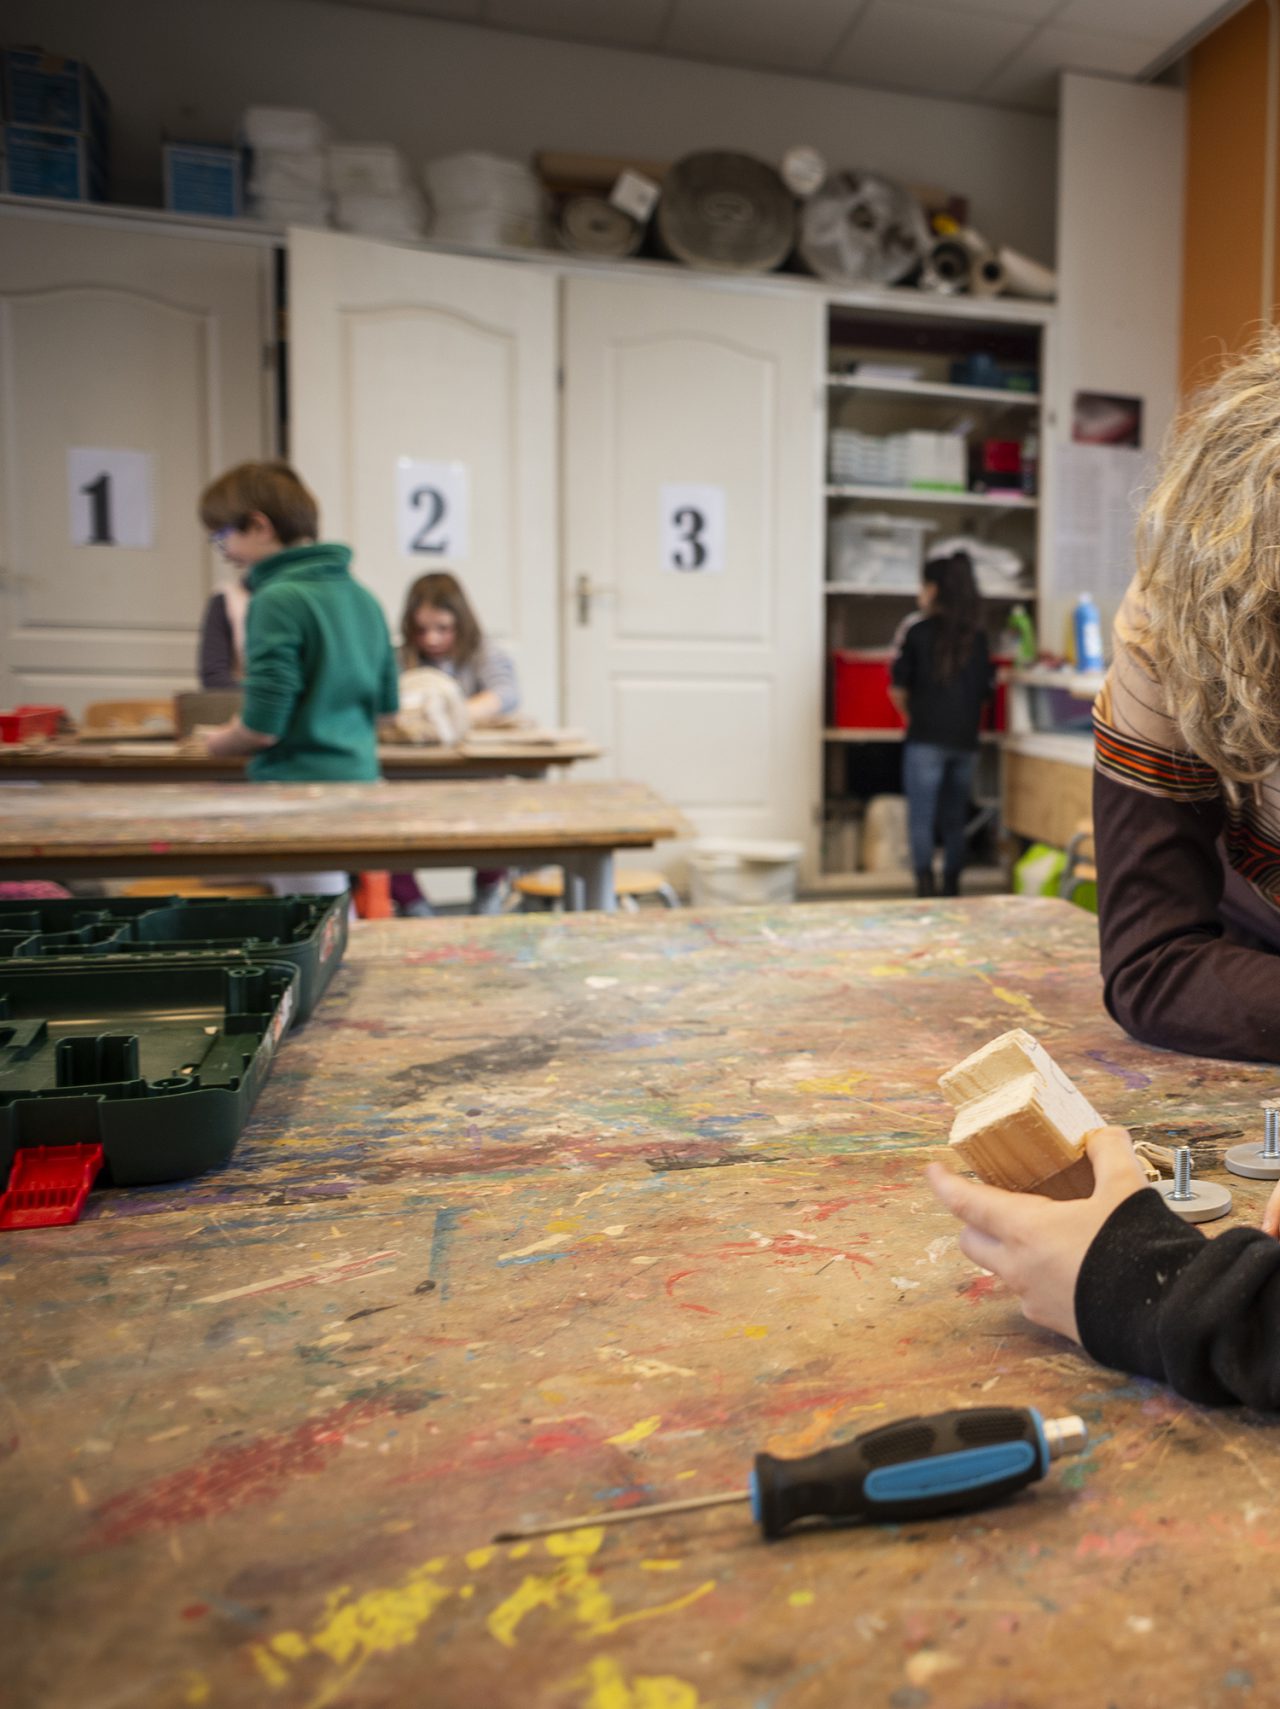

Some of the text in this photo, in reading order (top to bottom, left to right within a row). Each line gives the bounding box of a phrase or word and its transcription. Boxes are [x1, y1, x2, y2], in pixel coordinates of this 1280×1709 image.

[80, 471, 117, 546] 1
[409, 485, 448, 556] 2
[673, 506, 707, 572] 3
